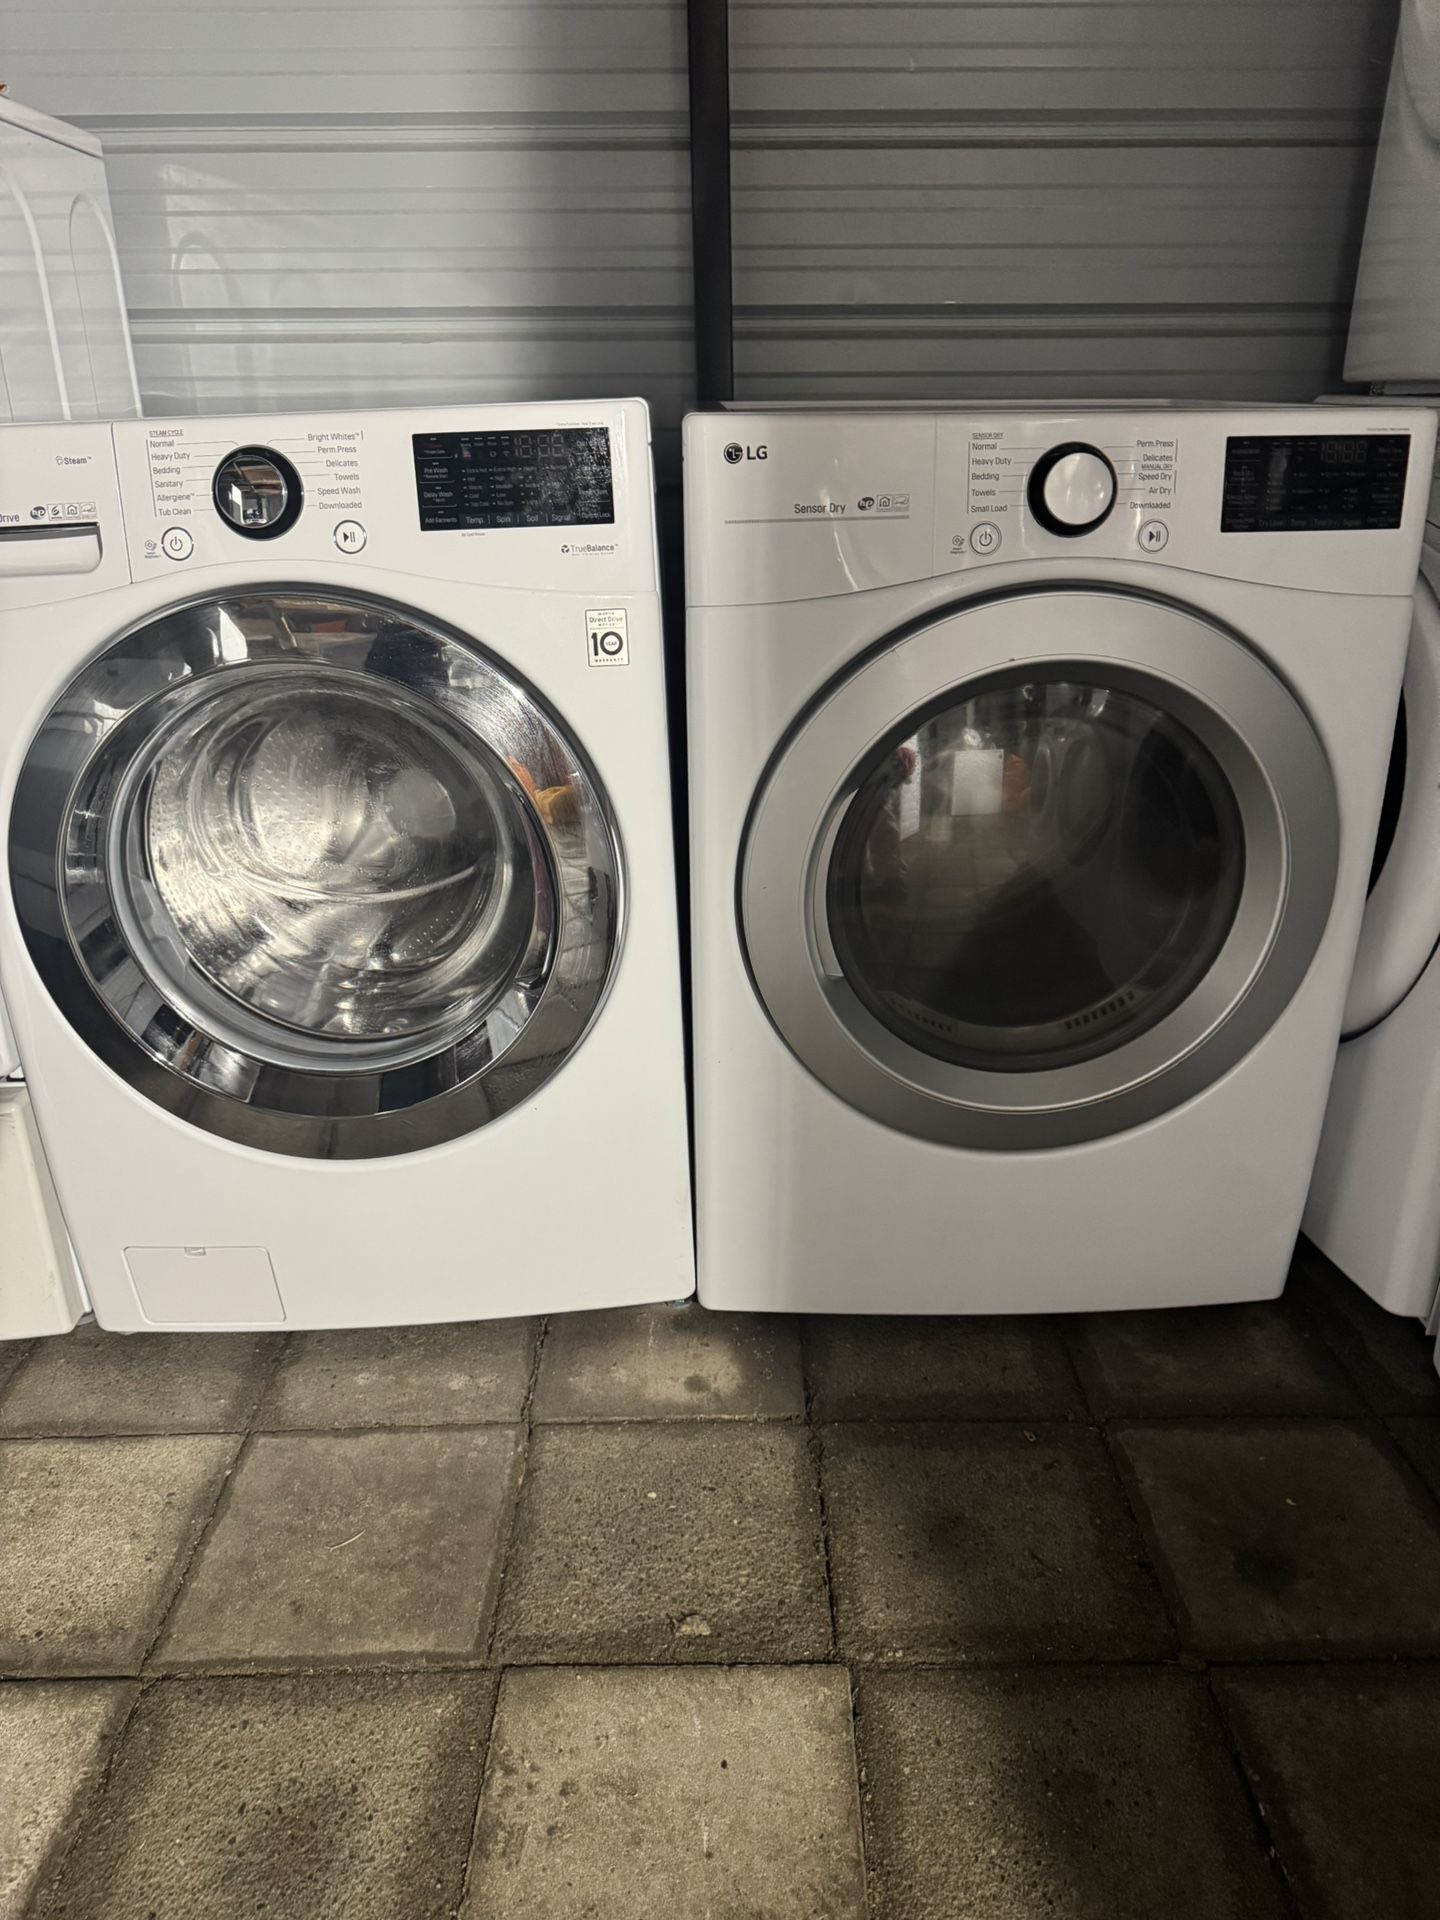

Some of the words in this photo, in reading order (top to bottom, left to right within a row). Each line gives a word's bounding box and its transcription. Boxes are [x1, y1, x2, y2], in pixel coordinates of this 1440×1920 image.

[308, 434, 329, 442] Bright
[150, 440, 174, 448] Normal
[151, 453, 173, 461] Heavy
[174, 452, 190, 460] Duty
[746, 445, 768, 460] LG
[972, 458, 993, 466] Heavy
[996, 457, 1012, 465] Duty
[153, 466, 181, 475] Bedding
[972, 473, 1000, 481] Bedding
[1138, 473, 1159, 481] Speed
[1161, 472, 1172, 480] Dry
[155, 480, 183, 488] Sanitary
[1160, 486, 1171, 495] Dry
[319, 501, 362, 509] Downloaded
[794, 504, 826, 514] Sensor
[829, 502, 846, 514] Dry
[991, 504, 1008, 512] Load
[591, 631, 623, 656] 10
